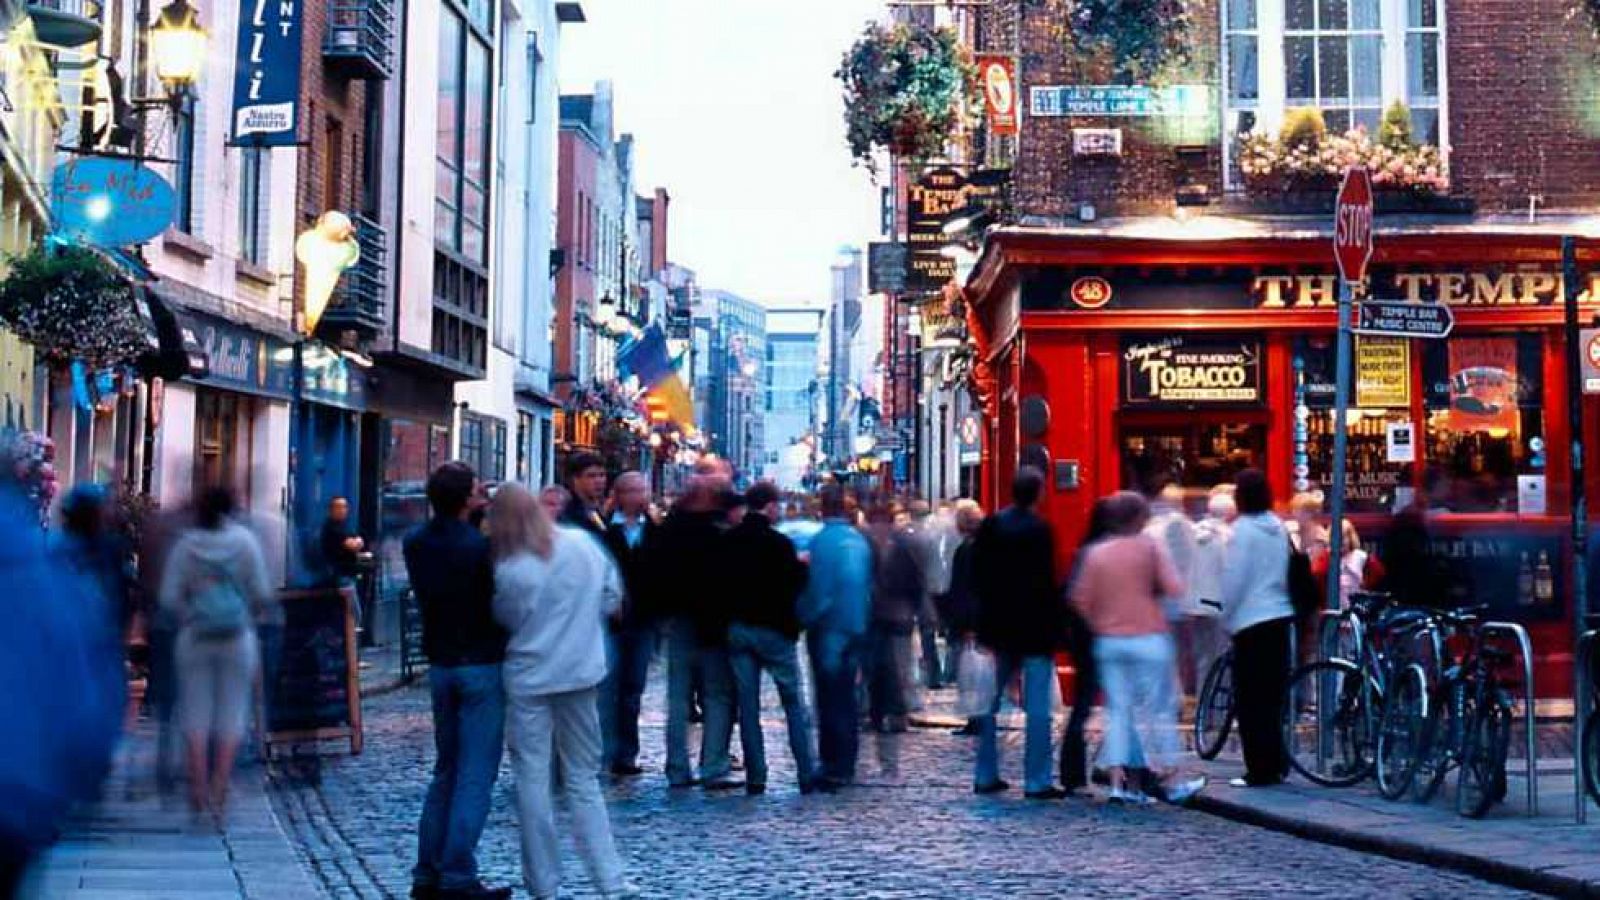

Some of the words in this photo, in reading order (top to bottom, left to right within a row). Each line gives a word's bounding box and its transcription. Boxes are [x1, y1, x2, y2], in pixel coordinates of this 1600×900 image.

[932, 175, 955, 185] THE
[1338, 203, 1371, 248] STOP
[1078, 281, 1104, 300] 48
[1396, 272, 1600, 304] TEMPL
[1381, 305, 1417, 318] TEMPLE
[1419, 308, 1438, 320] BAR
[1373, 318, 1405, 329] MUSIC
[1406, 320, 1444, 334] CENTRE
[1176, 353, 1198, 364] FINE
[1200, 353, 1244, 364] SMOKING
[1140, 360, 1245, 396] TOBACCO
[1320, 471, 1354, 484] LIE
[1359, 471, 1400, 484] MUSIC
